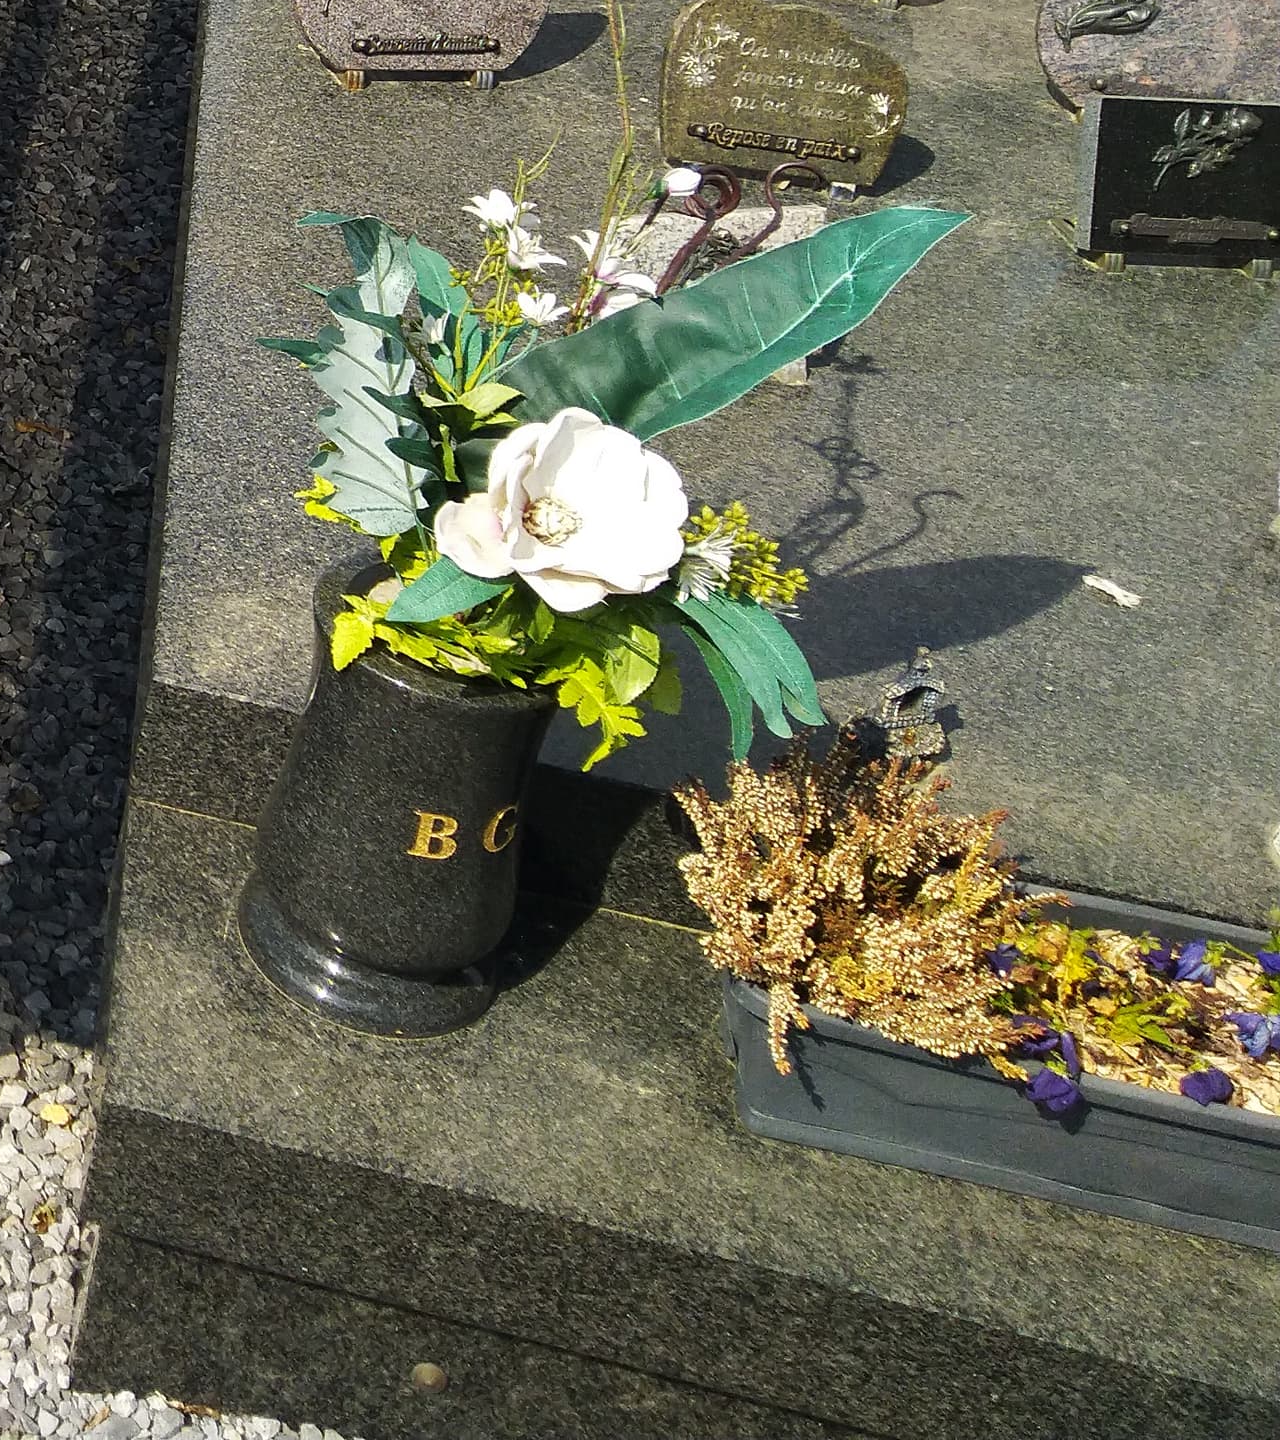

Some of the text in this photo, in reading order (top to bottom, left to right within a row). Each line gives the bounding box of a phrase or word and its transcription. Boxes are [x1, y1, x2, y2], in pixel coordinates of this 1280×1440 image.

[740, 36, 771, 59] On
[707, 121, 848, 162] Repose en paix
[407, 809, 459, 860] B
